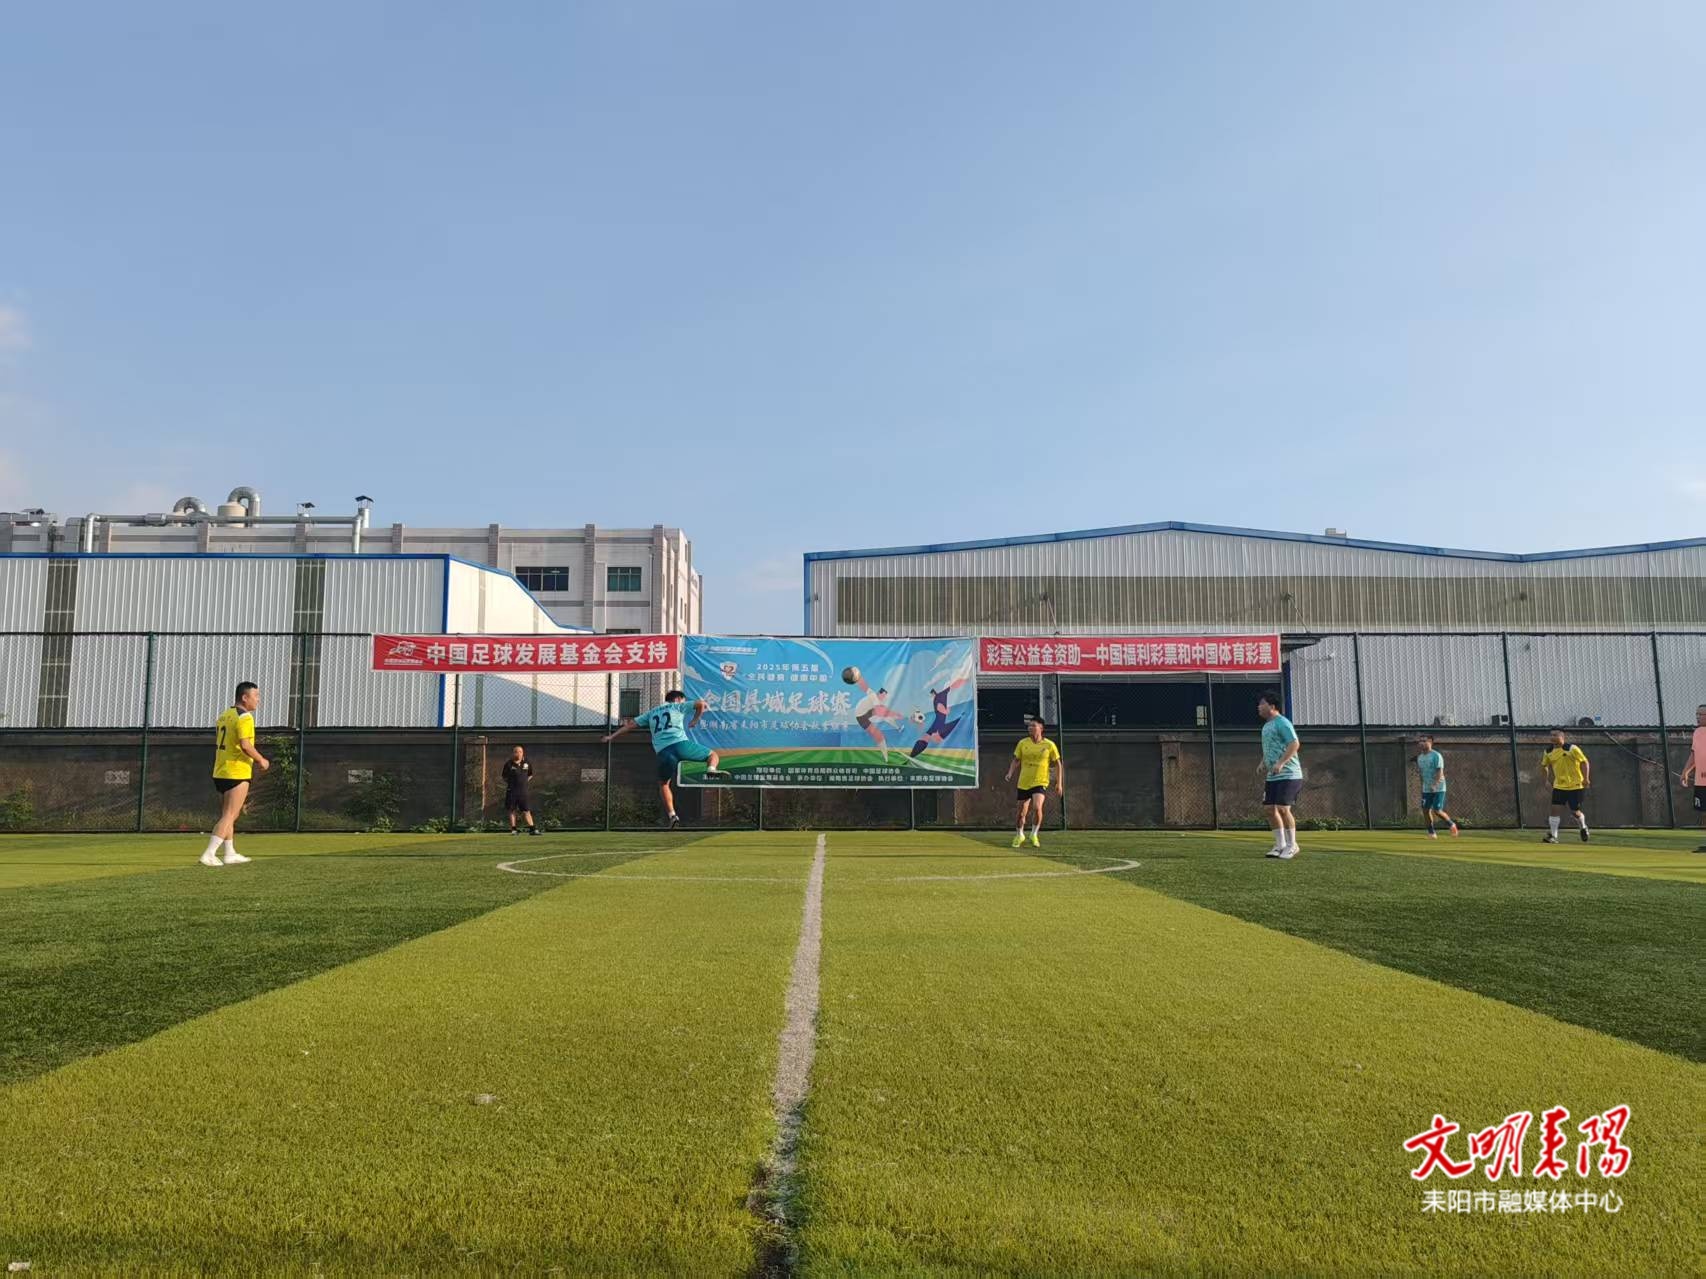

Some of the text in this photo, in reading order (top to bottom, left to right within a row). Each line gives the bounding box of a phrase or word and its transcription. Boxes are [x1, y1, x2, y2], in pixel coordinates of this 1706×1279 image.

[426, 641, 668, 666] 中国足球发展基金会支持
[703, 687, 851, 716] 全国县域足球赛
[653, 712, 672, 733] 22
